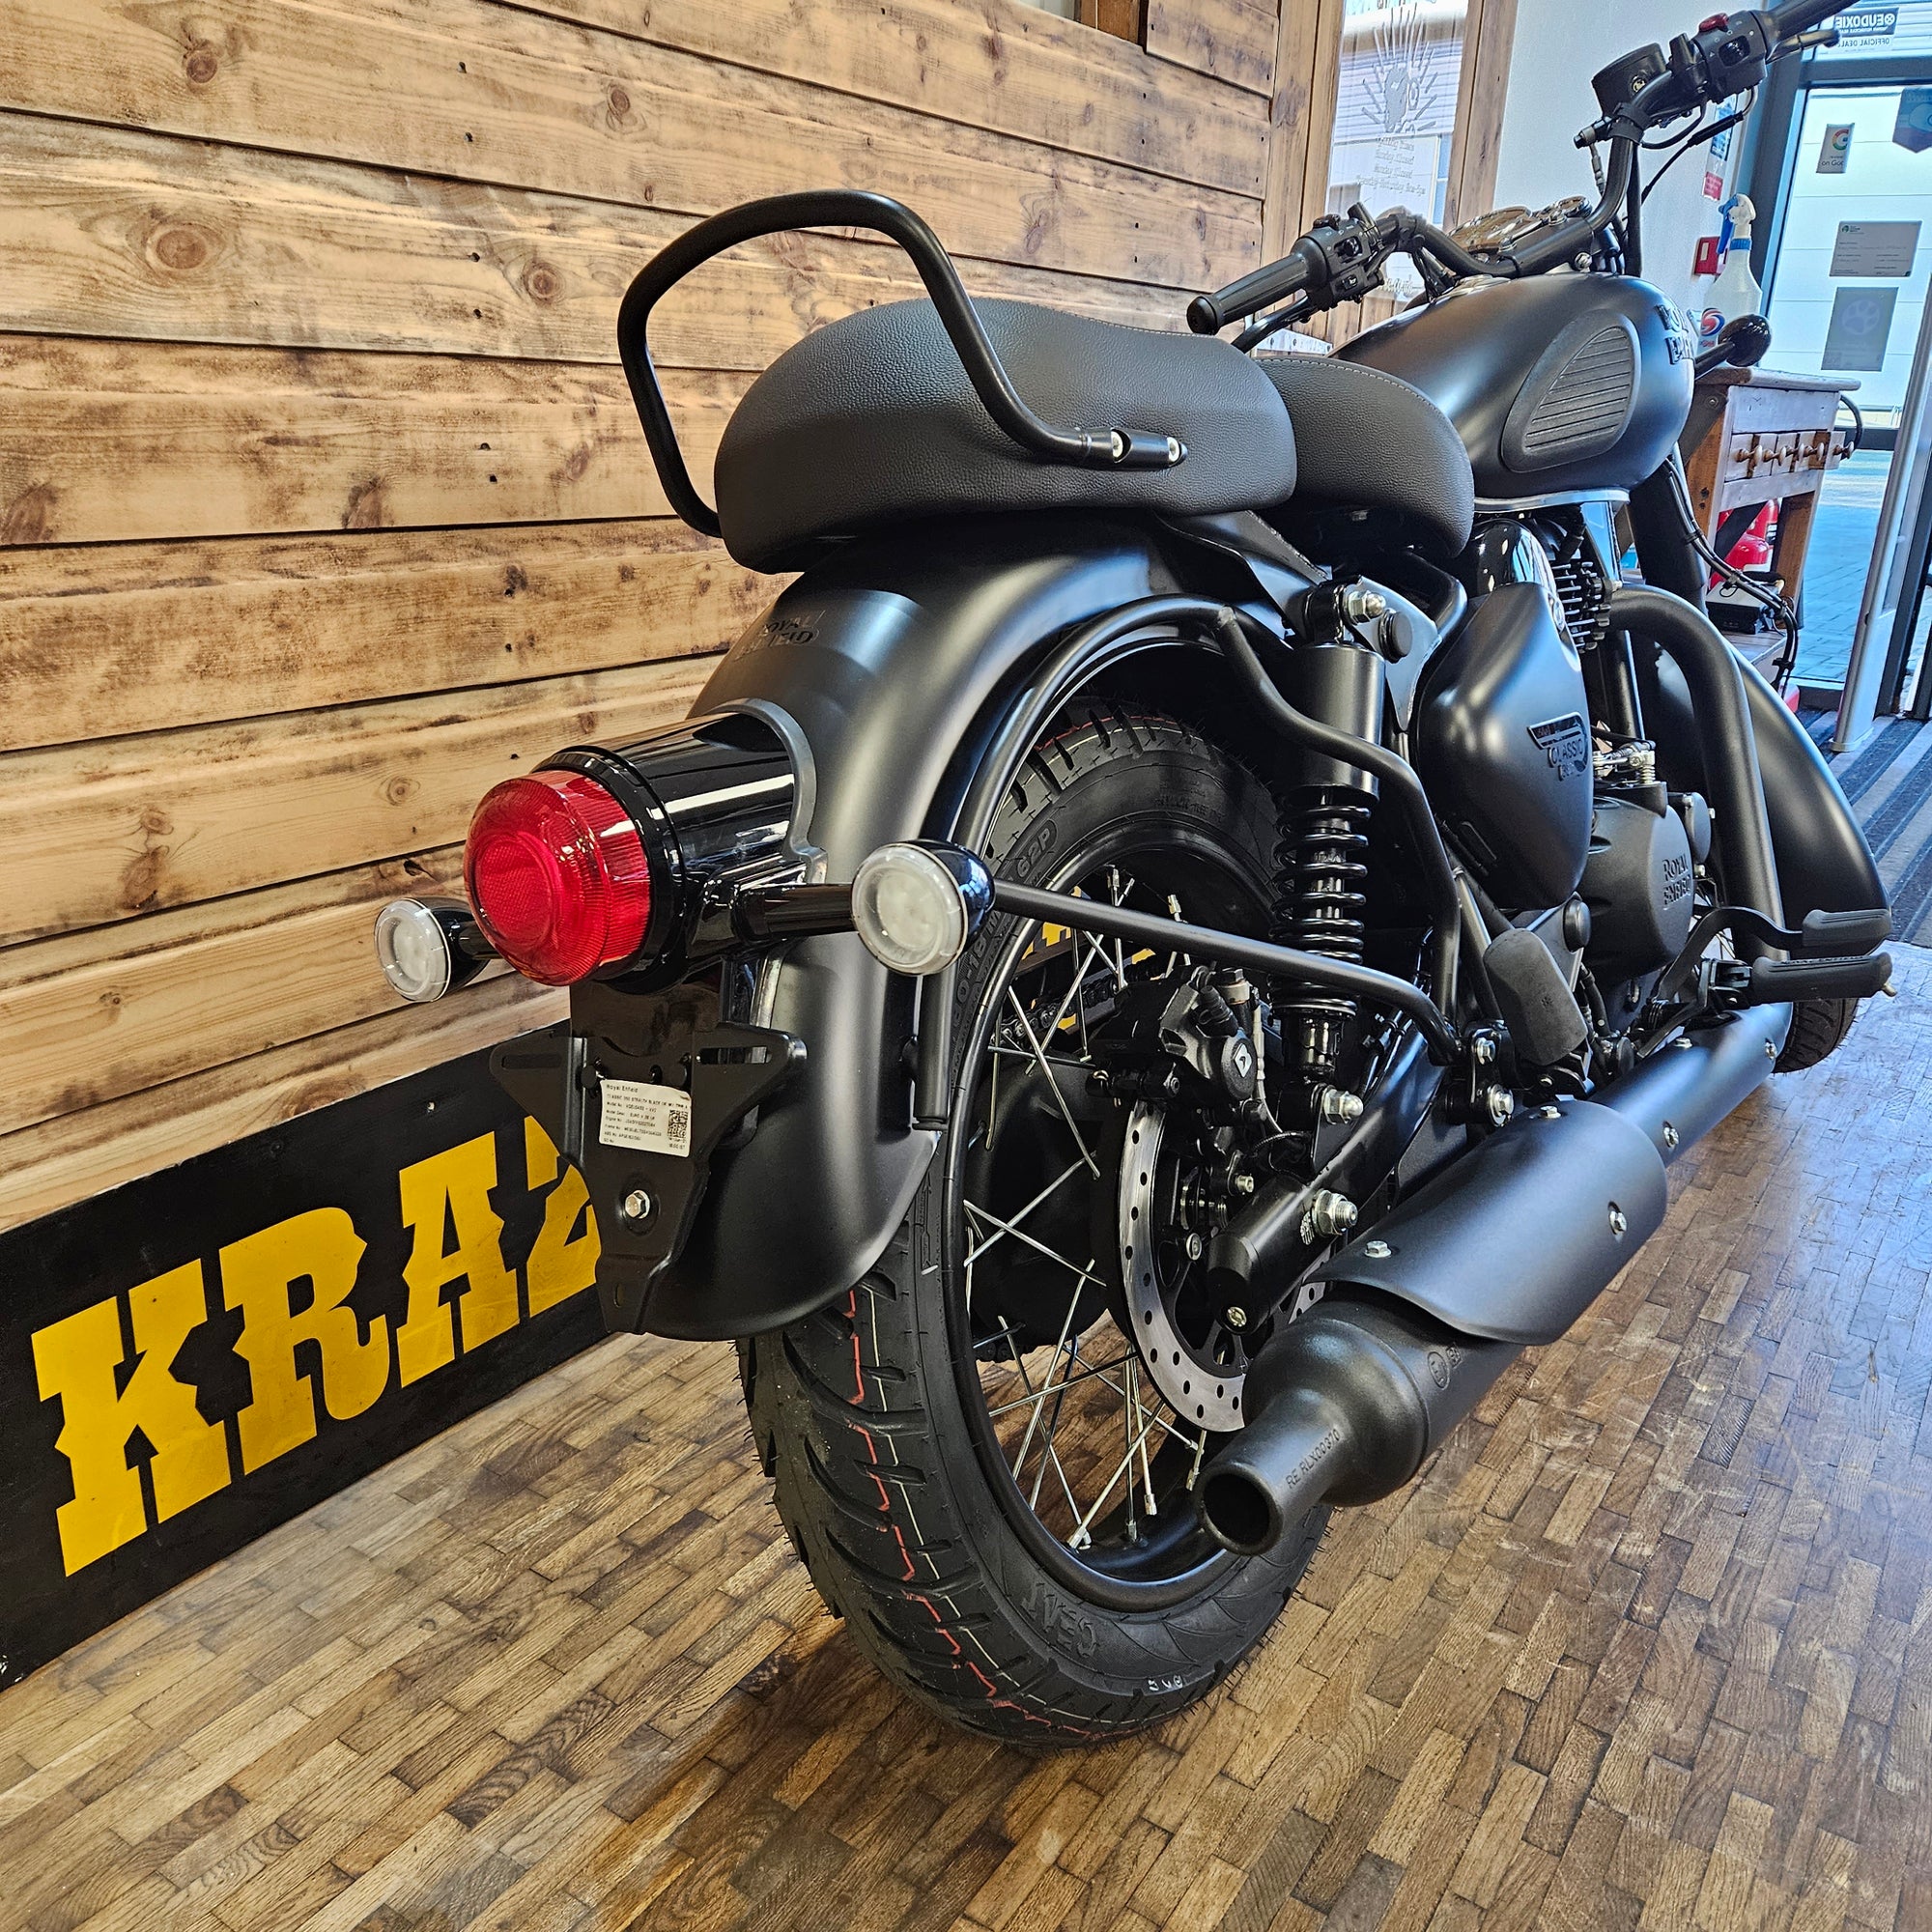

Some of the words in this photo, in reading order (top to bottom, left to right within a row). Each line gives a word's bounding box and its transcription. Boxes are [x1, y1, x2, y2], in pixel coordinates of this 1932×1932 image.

[1550, 738, 1584, 765] CLASSIC
[31, 1115, 602, 1577] KRAZ
[1286, 1468, 1301, 1489] RE
